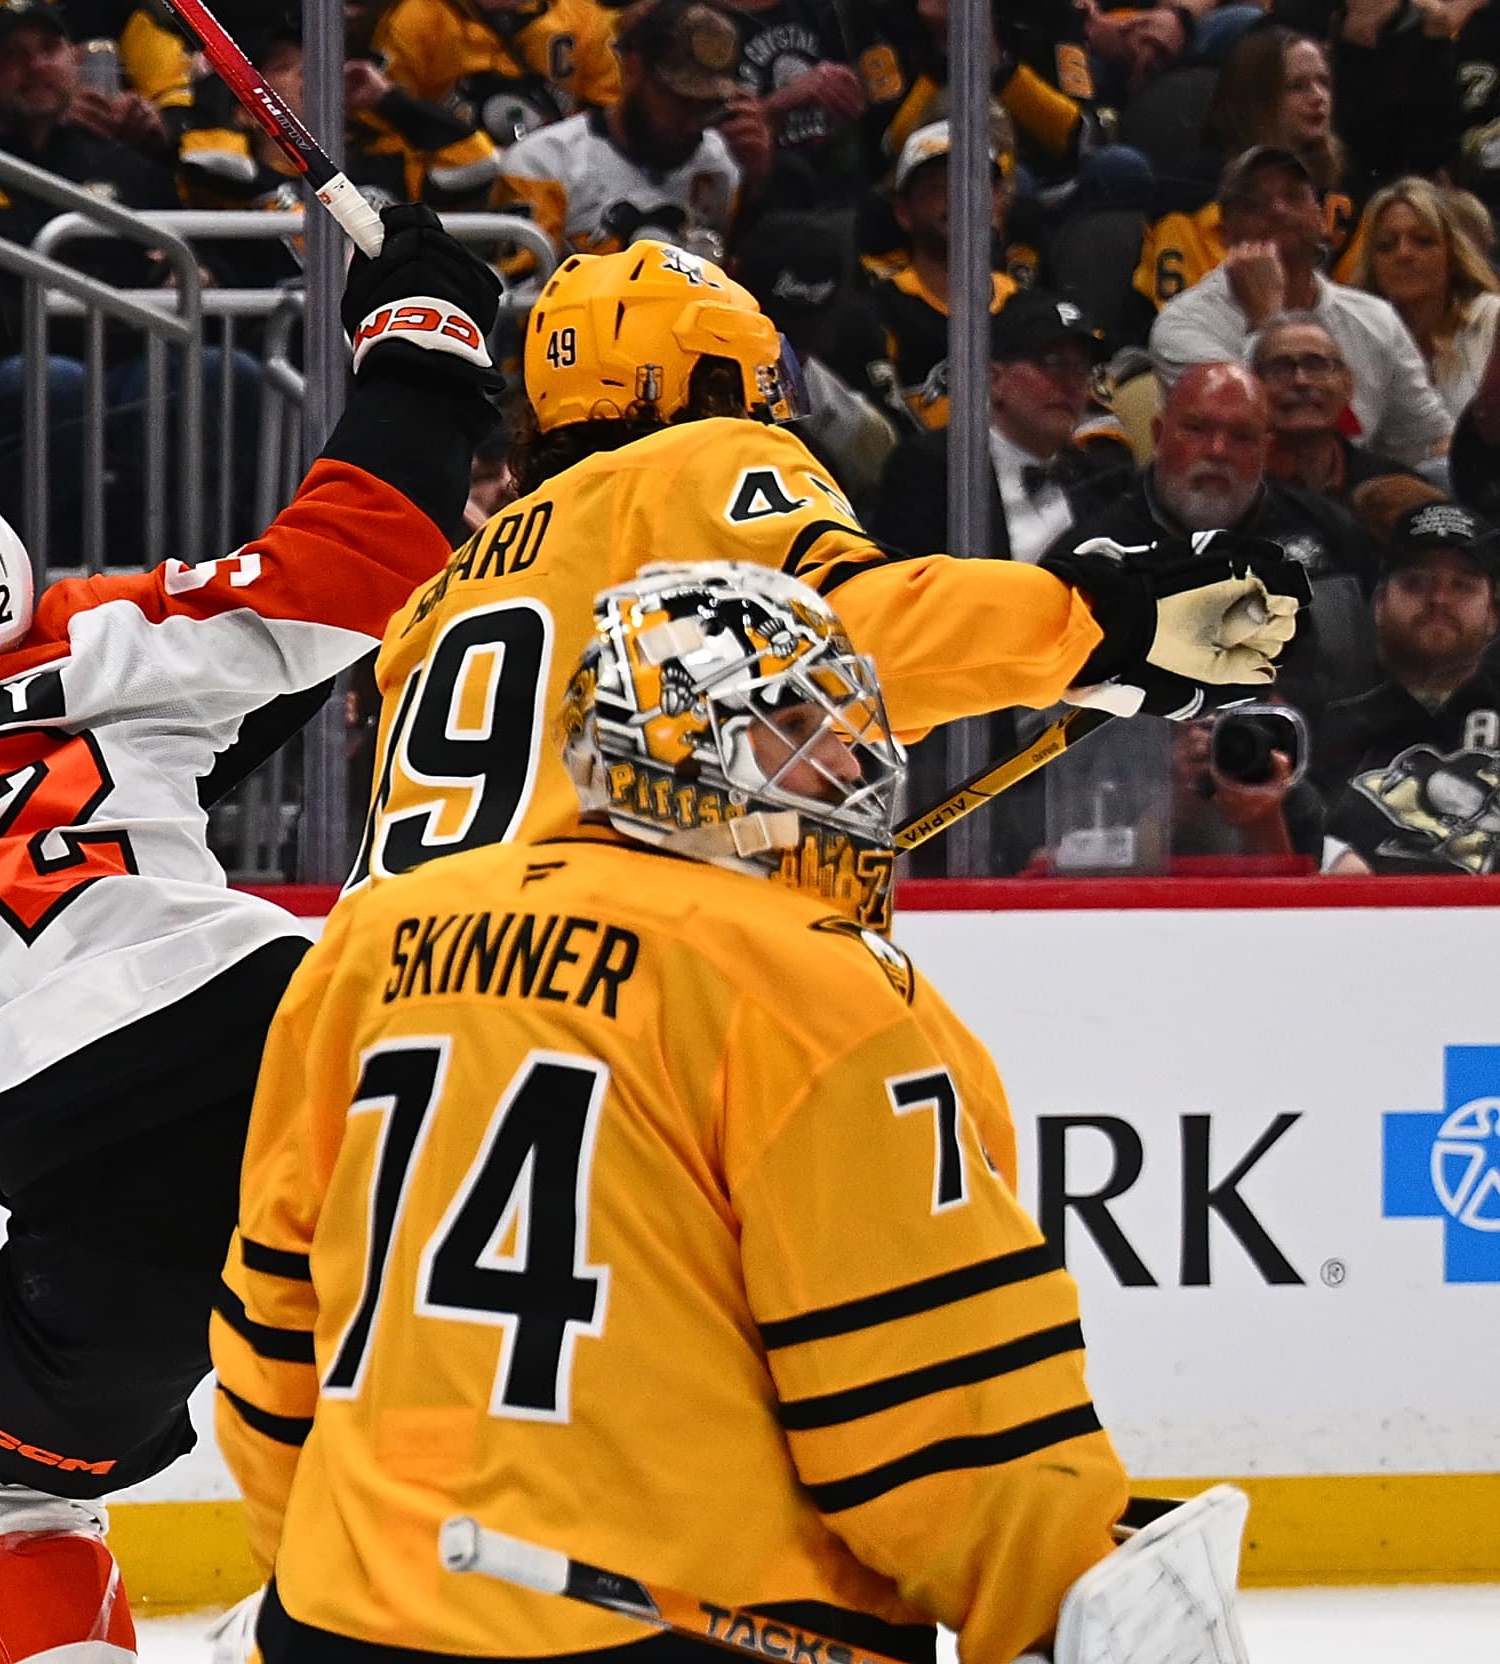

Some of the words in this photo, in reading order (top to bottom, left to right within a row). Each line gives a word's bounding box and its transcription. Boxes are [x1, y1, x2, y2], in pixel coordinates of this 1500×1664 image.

[546, 327, 577, 369] 49
[342, 597, 555, 896] 9
[904, 797, 968, 843] ALPHA
[383, 911, 641, 1020] SKINNER
[884, 1064, 1000, 1217] 7
[321, 1034, 613, 1425] 74
